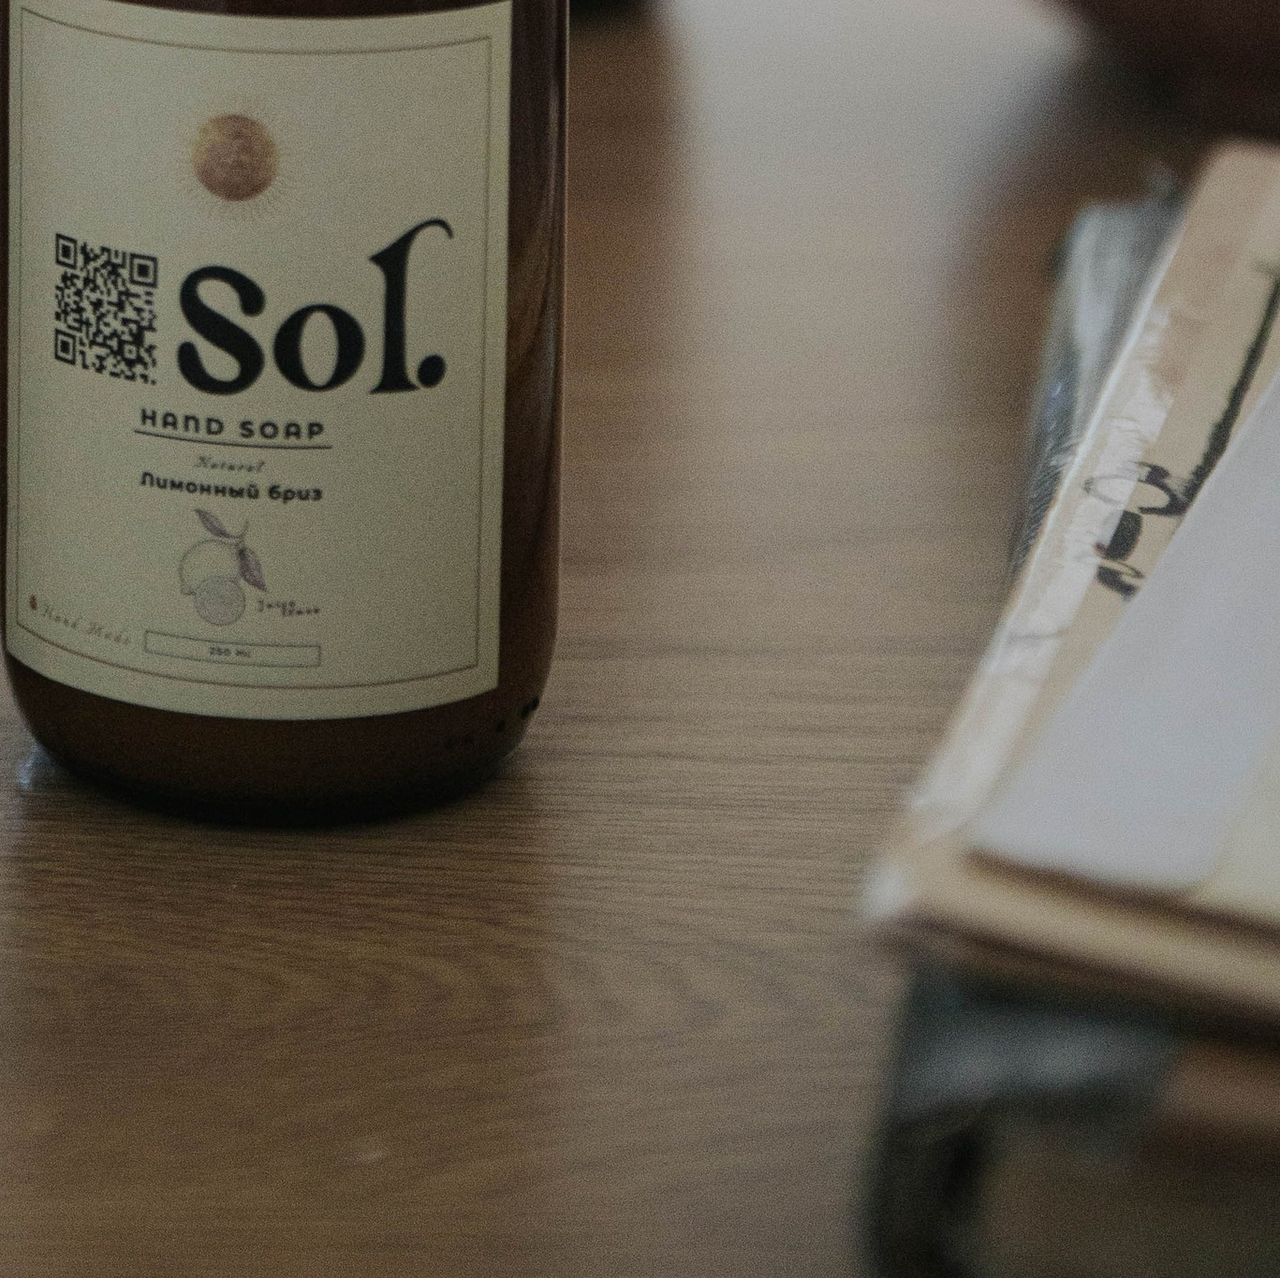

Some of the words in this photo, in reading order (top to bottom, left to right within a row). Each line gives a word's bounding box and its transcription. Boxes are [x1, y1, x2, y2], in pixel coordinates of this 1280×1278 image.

[176, 218, 454, 396] Sol.
[140, 408, 225, 435] HAND
[239, 420, 325, 441] SOAP
[194, 455, 266, 473] Natural
[139, 471, 261, 500] Лимонный
[267, 484, 324, 504] бриз
